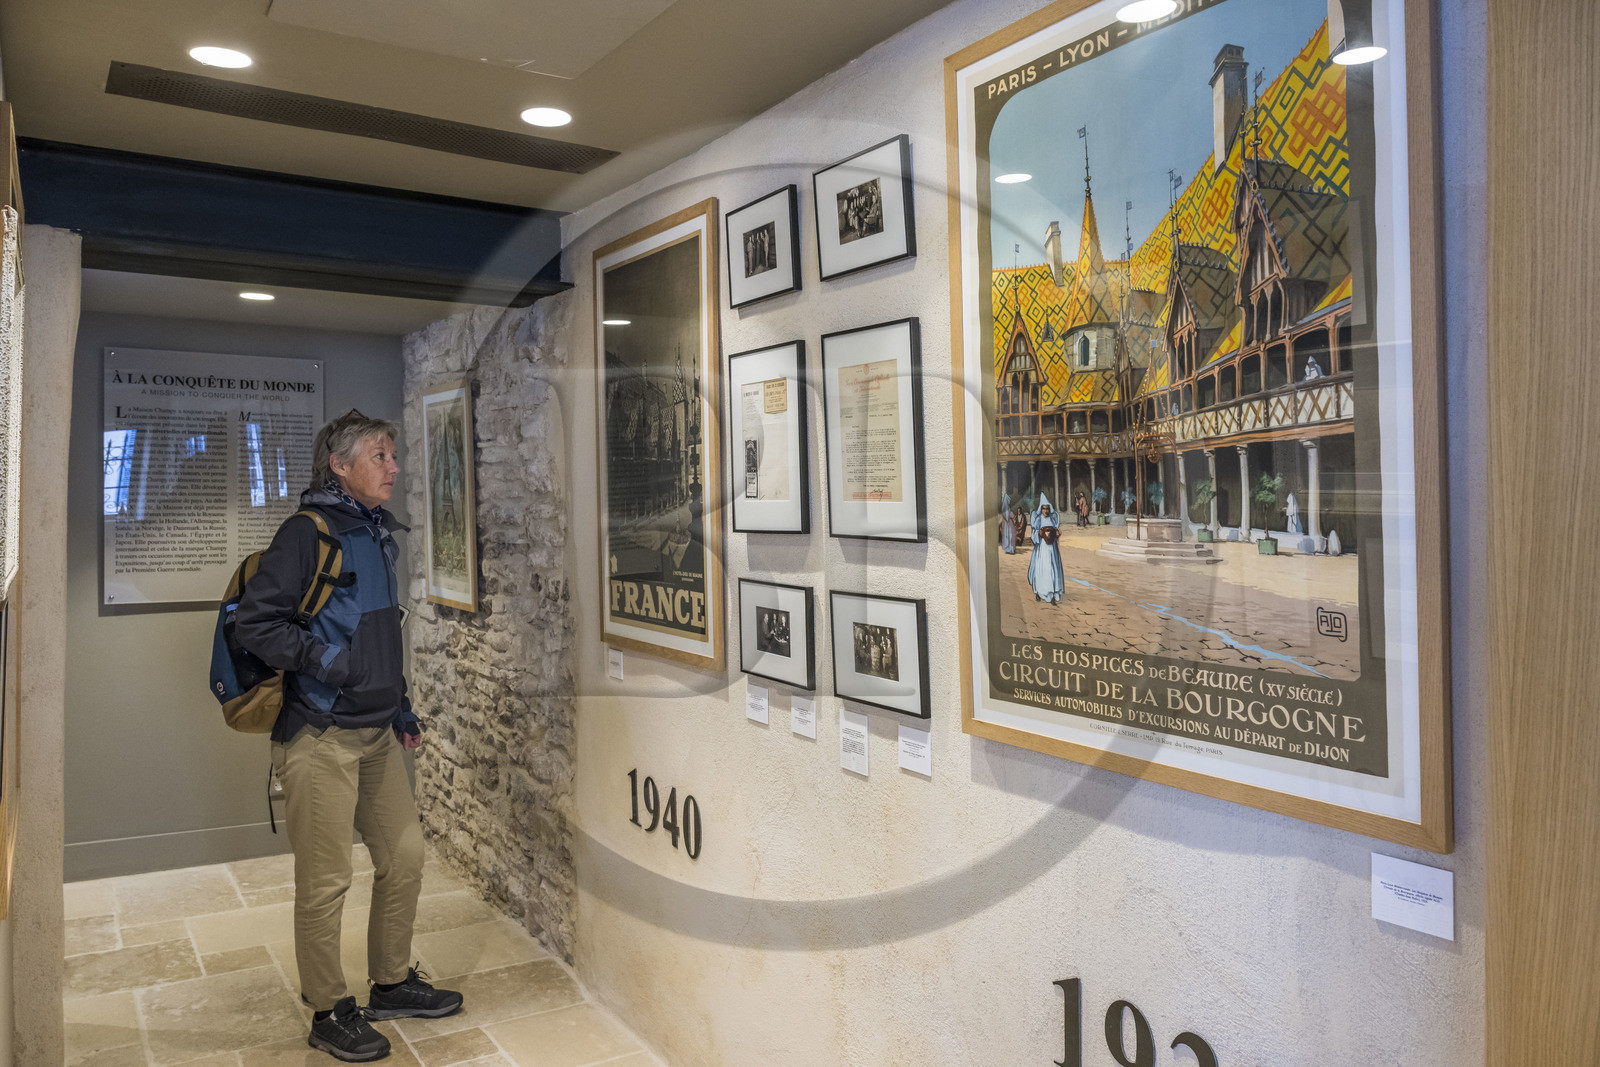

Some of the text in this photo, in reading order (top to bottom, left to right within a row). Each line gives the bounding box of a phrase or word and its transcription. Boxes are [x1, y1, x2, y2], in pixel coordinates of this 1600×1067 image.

[988, 65, 1037, 100] PARIS
[1059, 31, 1110, 68] LYON
[112, 370, 315, 393] À LA CONQUÊTE DU MONDE
[150, 389, 186, 397] MISSION
[202, 391, 242, 399] CONQUER
[262, 394, 290, 402] WORLD
[610, 579, 706, 629] FRANCE
[1011, 643, 1043, 661] LES
[1052, 649, 1145, 677] HOSPICES
[1168, 665, 1253, 694] BEAUNE
[999, 661, 1366, 743] CIRCUIT DE LA BOURGOGNE
[1013, 688, 1350, 763] SERVICES AUTOMOBILES D'EXCURSIONS AU DÉPART DE DIJON
[627, 767, 703, 860] 1940
